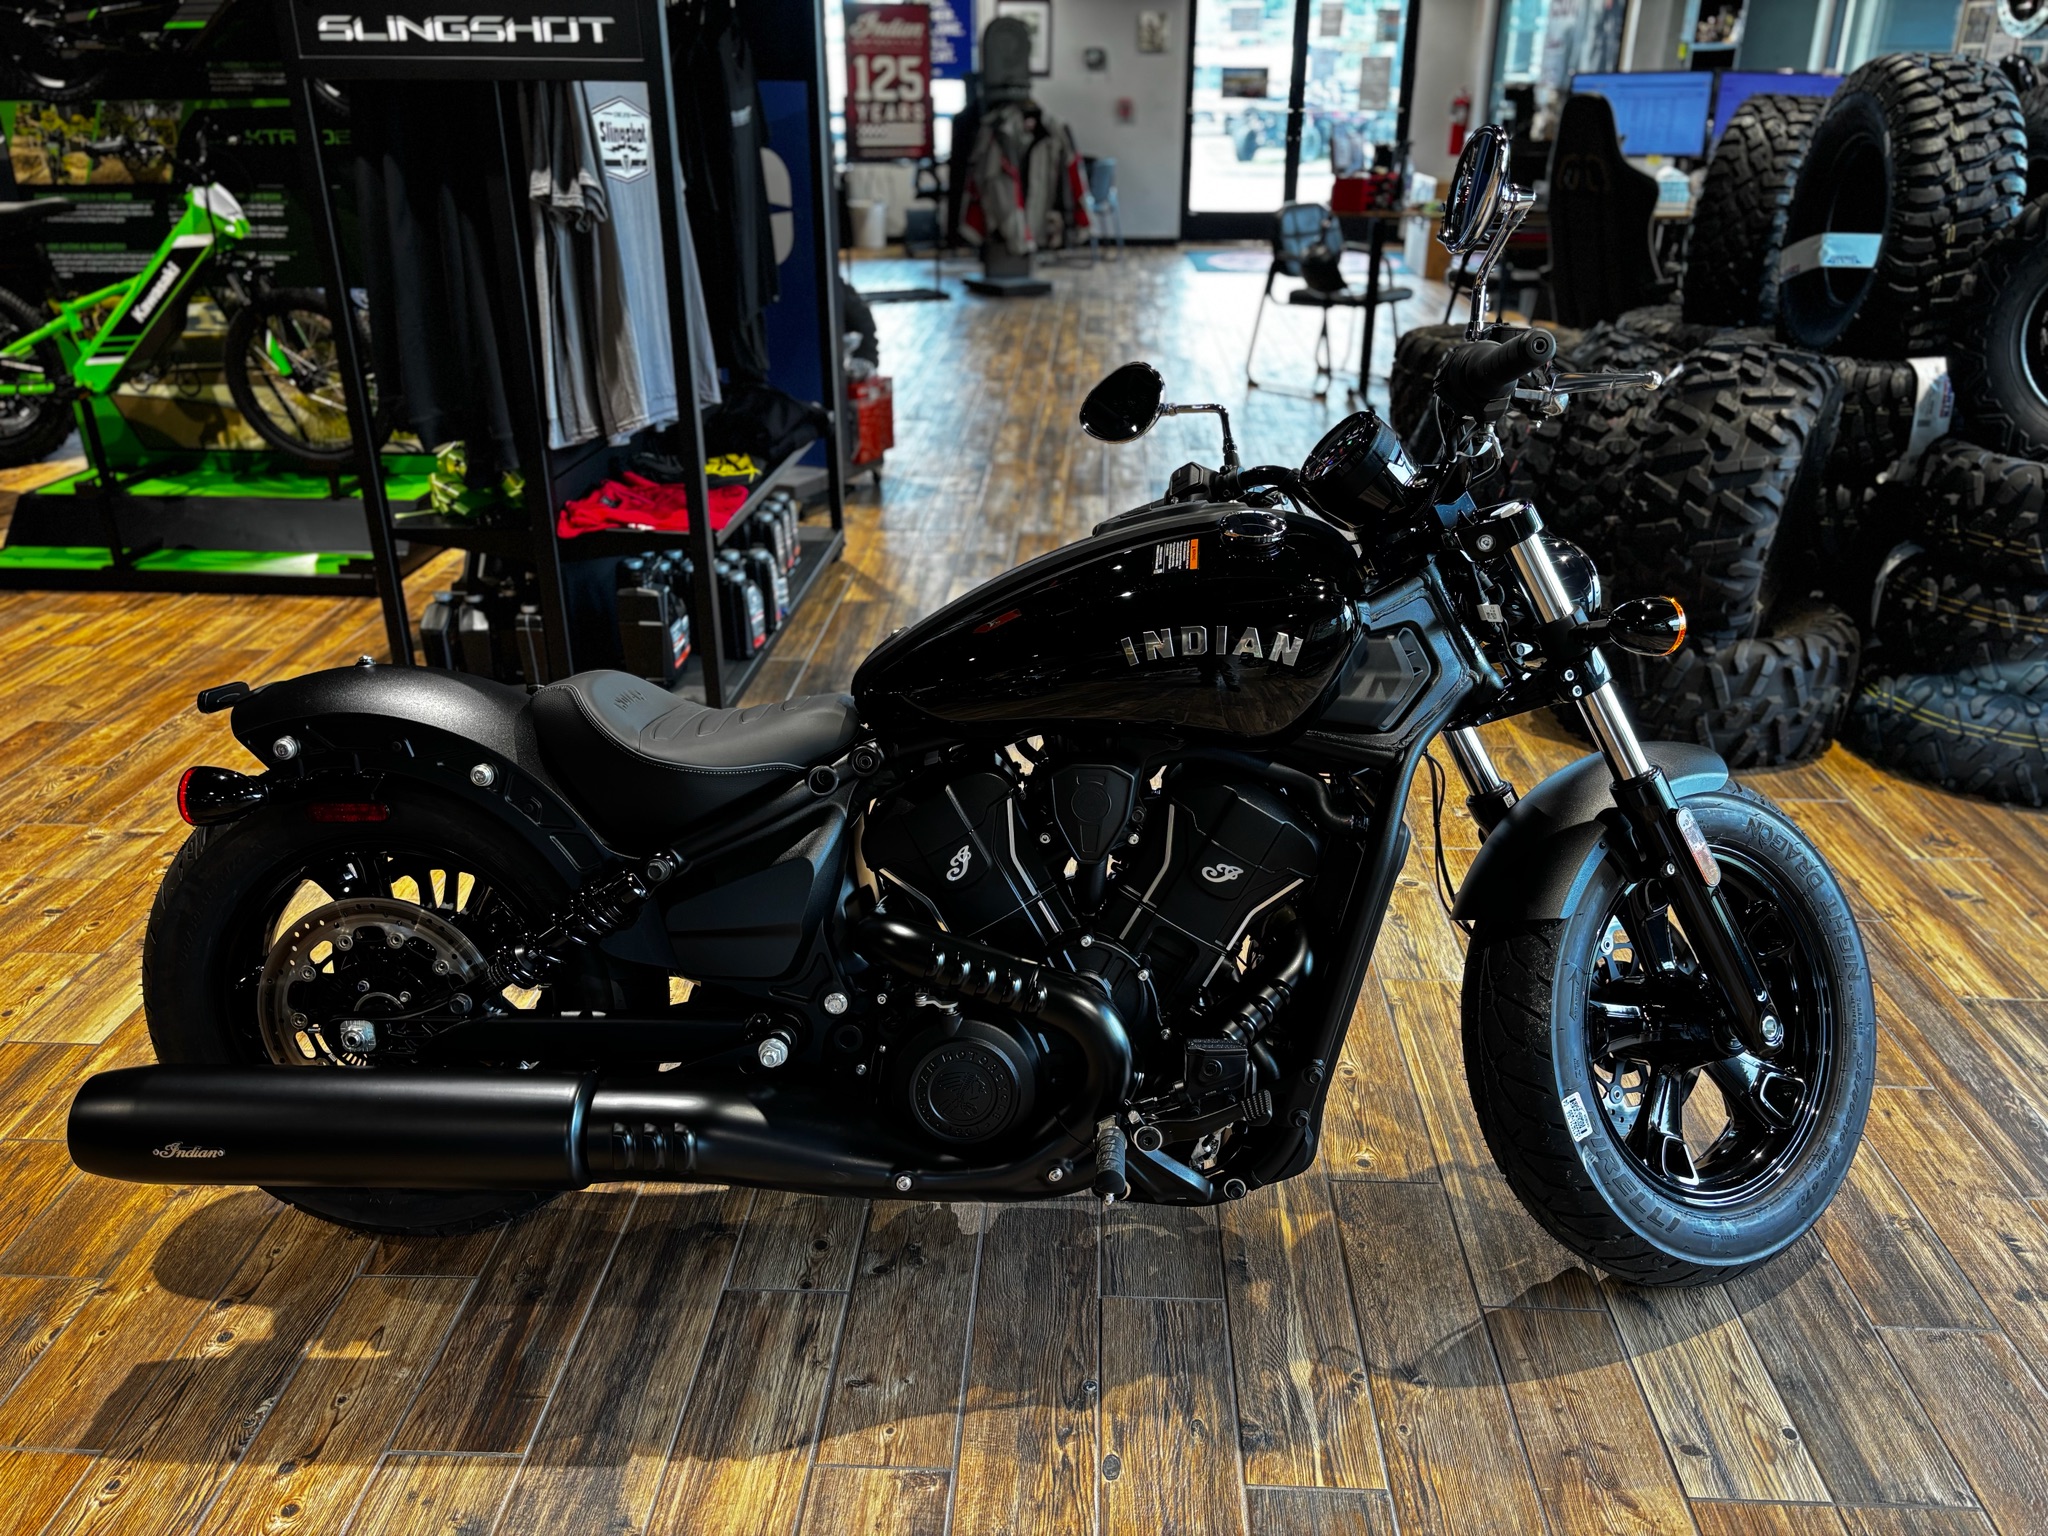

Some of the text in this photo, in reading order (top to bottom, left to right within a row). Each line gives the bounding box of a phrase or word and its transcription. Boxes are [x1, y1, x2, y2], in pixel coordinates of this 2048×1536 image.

[317, 15, 615, 43] SLINGSHOT
[850, 11, 925, 40] Indian
[854, 54, 924, 101] 125
[855, 102, 926, 122] YEARS
[598, 122, 646, 147] Slingshot
[131, 260, 181, 324] Kawasaki
[1120, 625, 1304, 667] INDIAN
[1744, 816, 1862, 982] NIGHT DRAGON
[155, 1141, 222, 1159] Indian
[1586, 1109, 1681, 1234] PIRELLI
